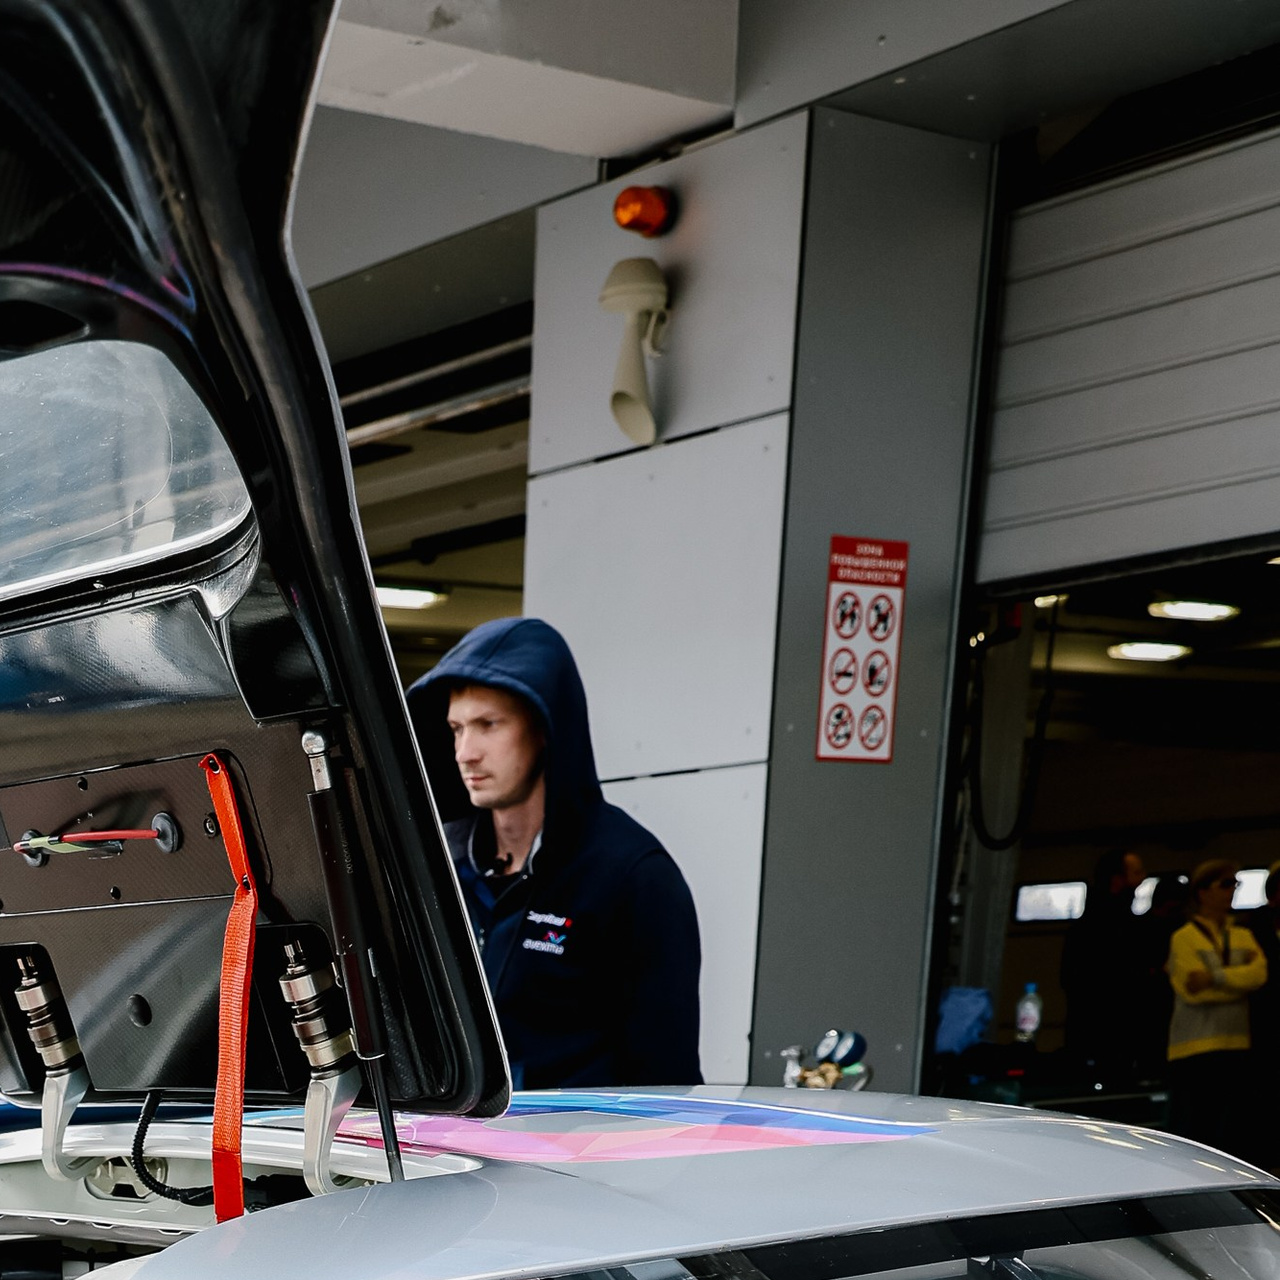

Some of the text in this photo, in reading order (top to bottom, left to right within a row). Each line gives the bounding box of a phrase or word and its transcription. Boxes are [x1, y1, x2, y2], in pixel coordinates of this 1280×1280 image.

[856, 543, 884, 556] ЗОНА
[831, 553, 906, 571] ПОВЫШЕННОЙ
[837, 566, 900, 583] ОПАСНОСТИ
